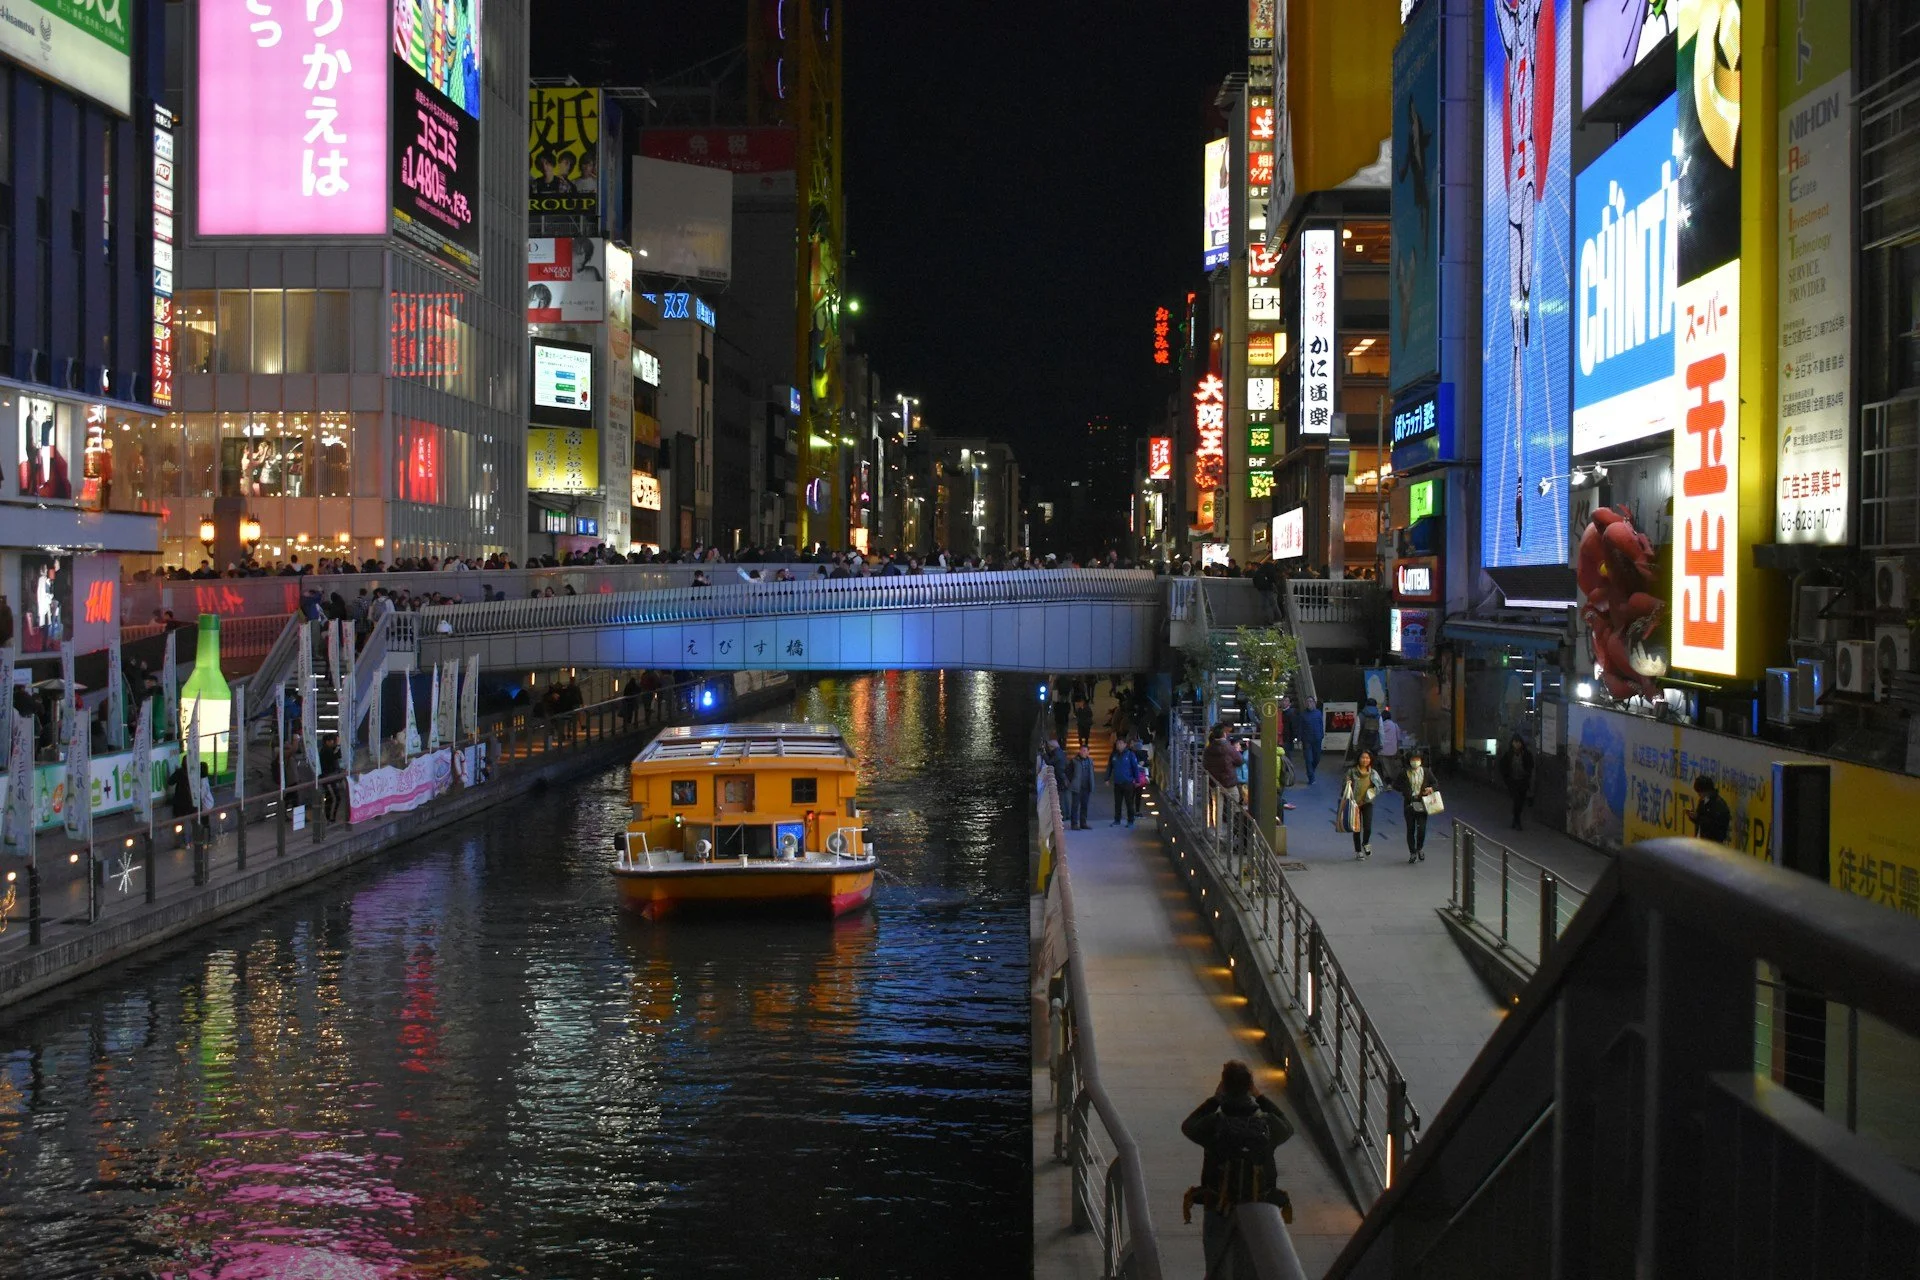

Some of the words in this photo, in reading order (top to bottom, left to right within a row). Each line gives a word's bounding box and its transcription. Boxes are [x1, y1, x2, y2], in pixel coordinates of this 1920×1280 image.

[1251, 98, 1268, 107] 8F
[1788, 92, 1839, 143] NIHON
[417, 109, 457, 173] コミコミ
[1788, 176, 1818, 203] Estate
[1788, 203, 1829, 232] Investment
[1788, 233, 1832, 262] Technology
[1788, 258, 1820, 284] SERVICE
[1311, 262, 1328, 327] 本場の味
[1788, 277, 1826, 304] PROVIDER
[1685, 291, 1729, 343] スーパー
[163, 300, 172, 395] インターネット
[1154, 306, 1170, 364] お好み焼
[154, 339, 162, 393] コミック
[1310, 335, 1329, 425] かに道楽
[1249, 412, 1267, 422] 1F
[1780, 467, 1842, 500] 広告主募集中
[687, 639, 803, 657] えびす橋
